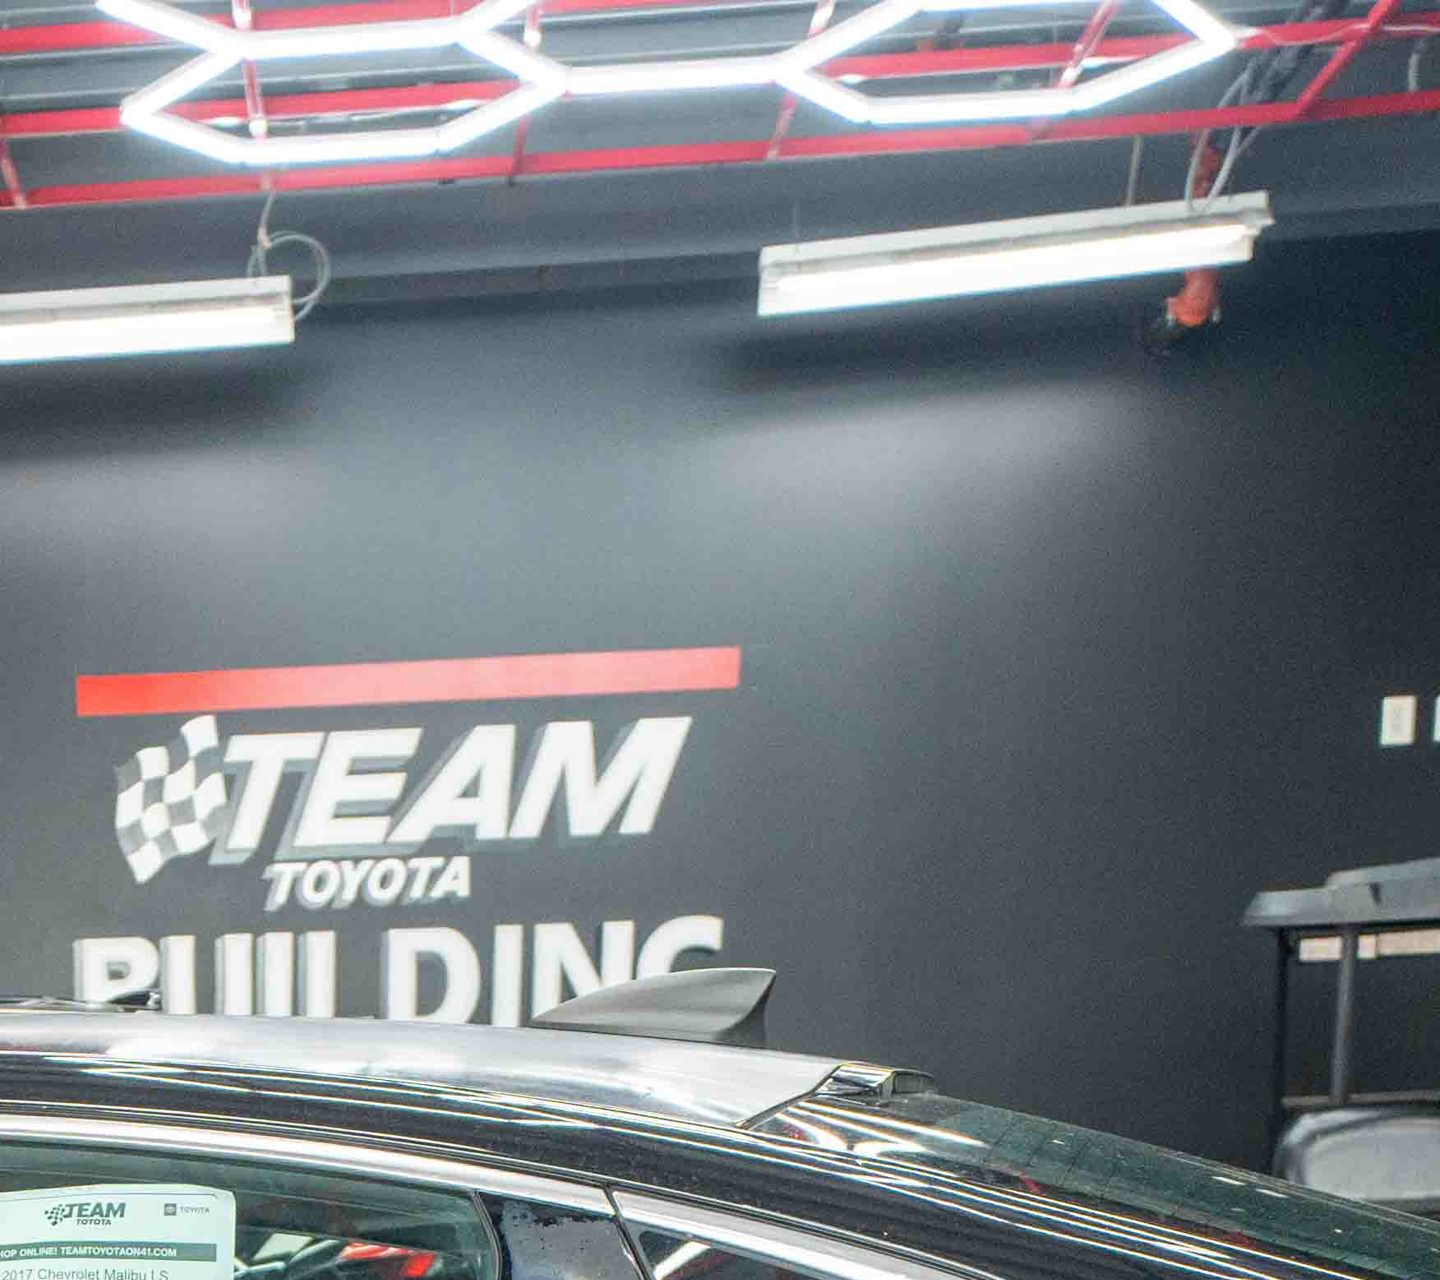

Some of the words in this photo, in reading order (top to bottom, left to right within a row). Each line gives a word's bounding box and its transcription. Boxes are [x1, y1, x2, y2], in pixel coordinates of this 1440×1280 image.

[215, 715, 694, 862] TEAM
[262, 855, 471, 911] TOYOTA
[63, 1202, 127, 1218] TEAM
[180, 1206, 211, 1214] TOYOTA
[76, 1218, 112, 1226] TOYOTA
[19, 1246, 58, 1257] ONLINE!
[60, 1246, 177, 1258] TEAMTOYOTAON41.COM
[37, 1269, 100, 1280] Chevrolet
